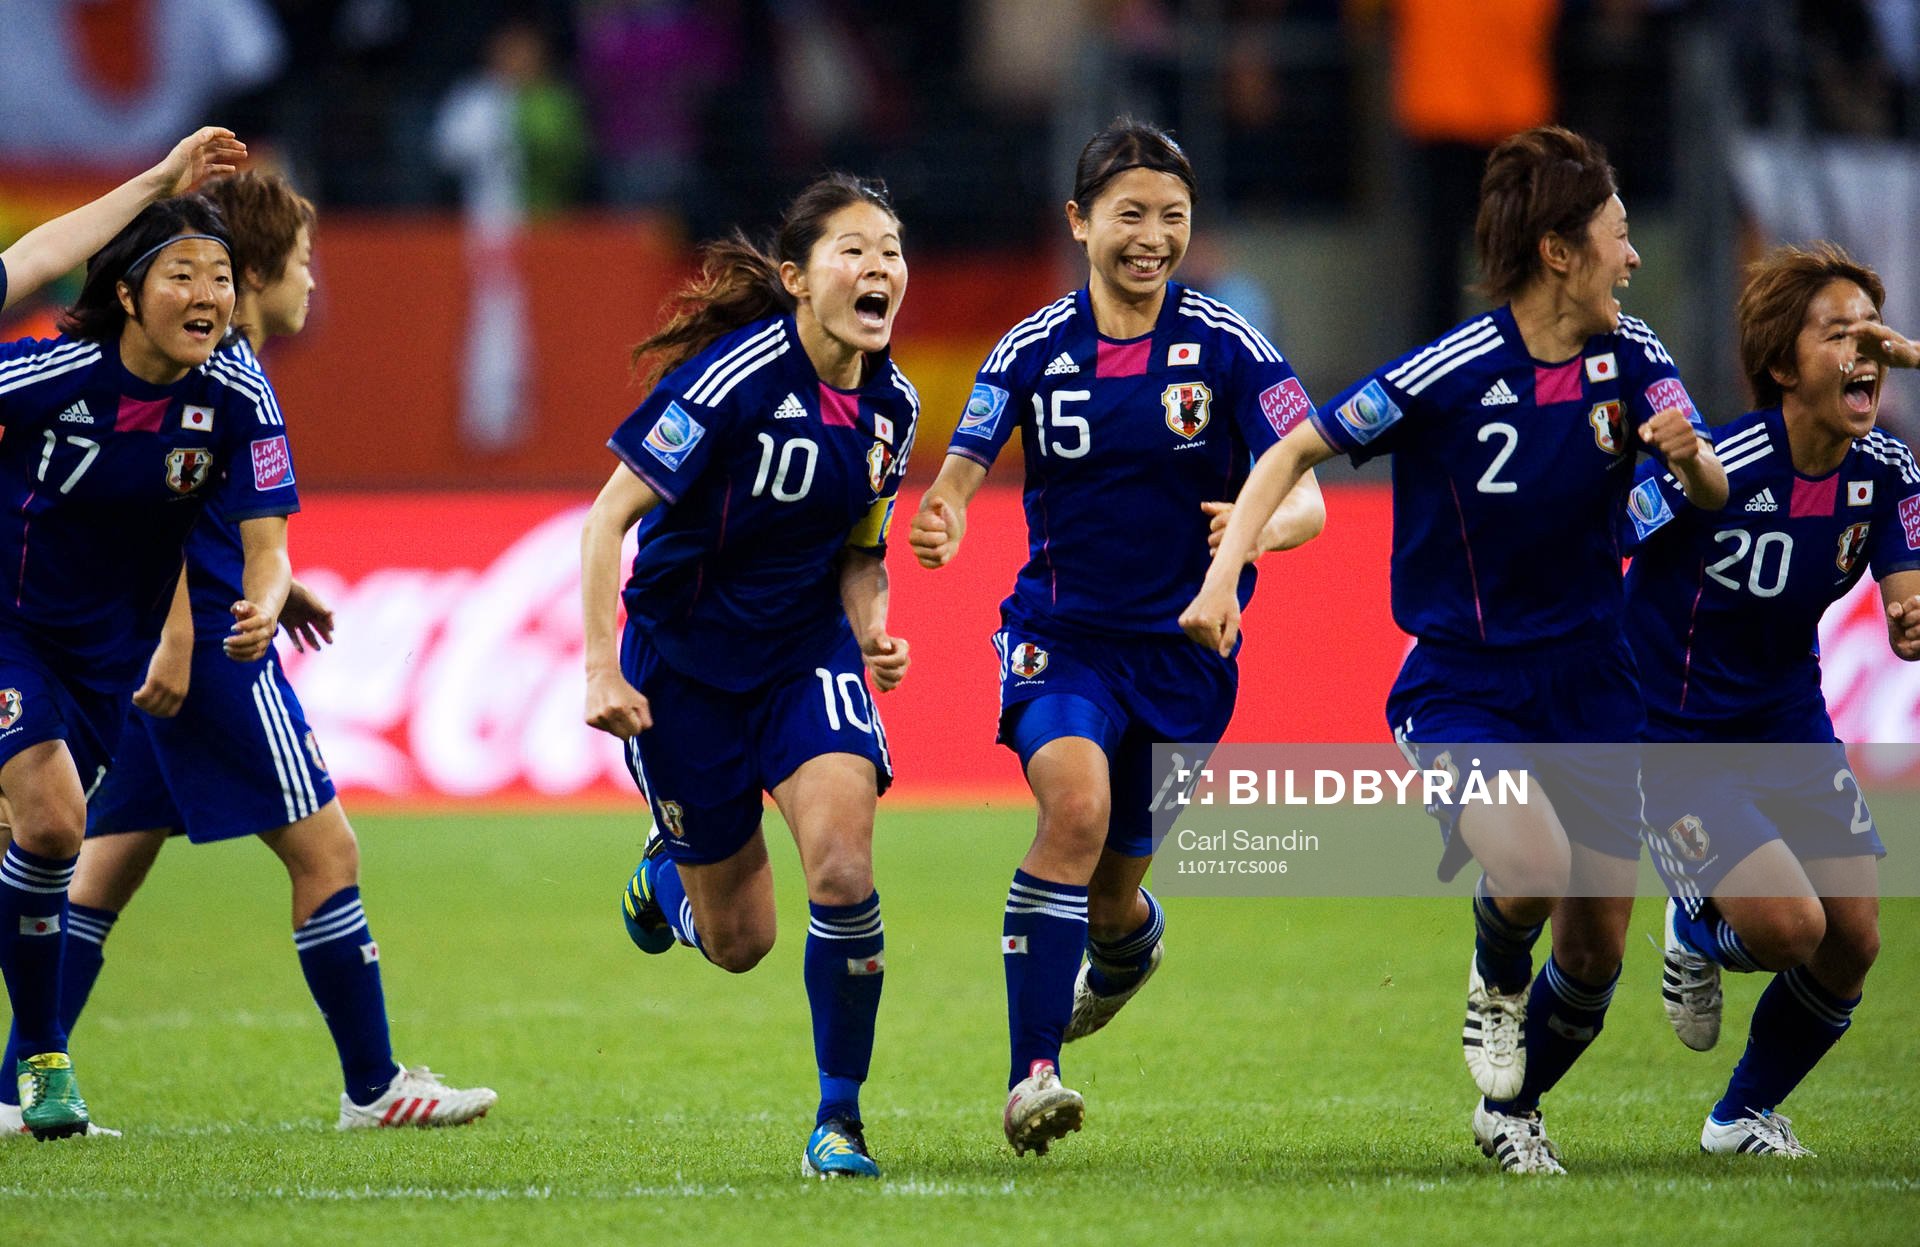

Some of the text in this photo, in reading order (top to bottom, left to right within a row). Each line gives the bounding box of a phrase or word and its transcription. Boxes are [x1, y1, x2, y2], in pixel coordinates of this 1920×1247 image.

[1044, 363, 1080, 376] adidas
[1264, 384, 1288, 410] LIVE
[1268, 391, 1301, 420] YOUR
[1480, 394, 1519, 406] adidas
[59, 411, 94, 425] adidas
[774, 407, 808, 420] adidas
[1031, 389, 1091, 459] 15
[1276, 397, 1308, 431] GOALS
[255, 440, 278, 459] LIVE
[1173, 440, 1206, 450] JAPAN
[1476, 422, 1519, 494] 2
[37, 429, 101, 495] 17
[255, 450, 285, 472] YOUR
[257, 458, 288, 484] GOALS
[751, 432, 819, 503] 10
[1744, 501, 1779, 513] adidas
[1902, 496, 1920, 518] LIV
[1705, 528, 1794, 598] 20
[815, 667, 872, 734] 10
